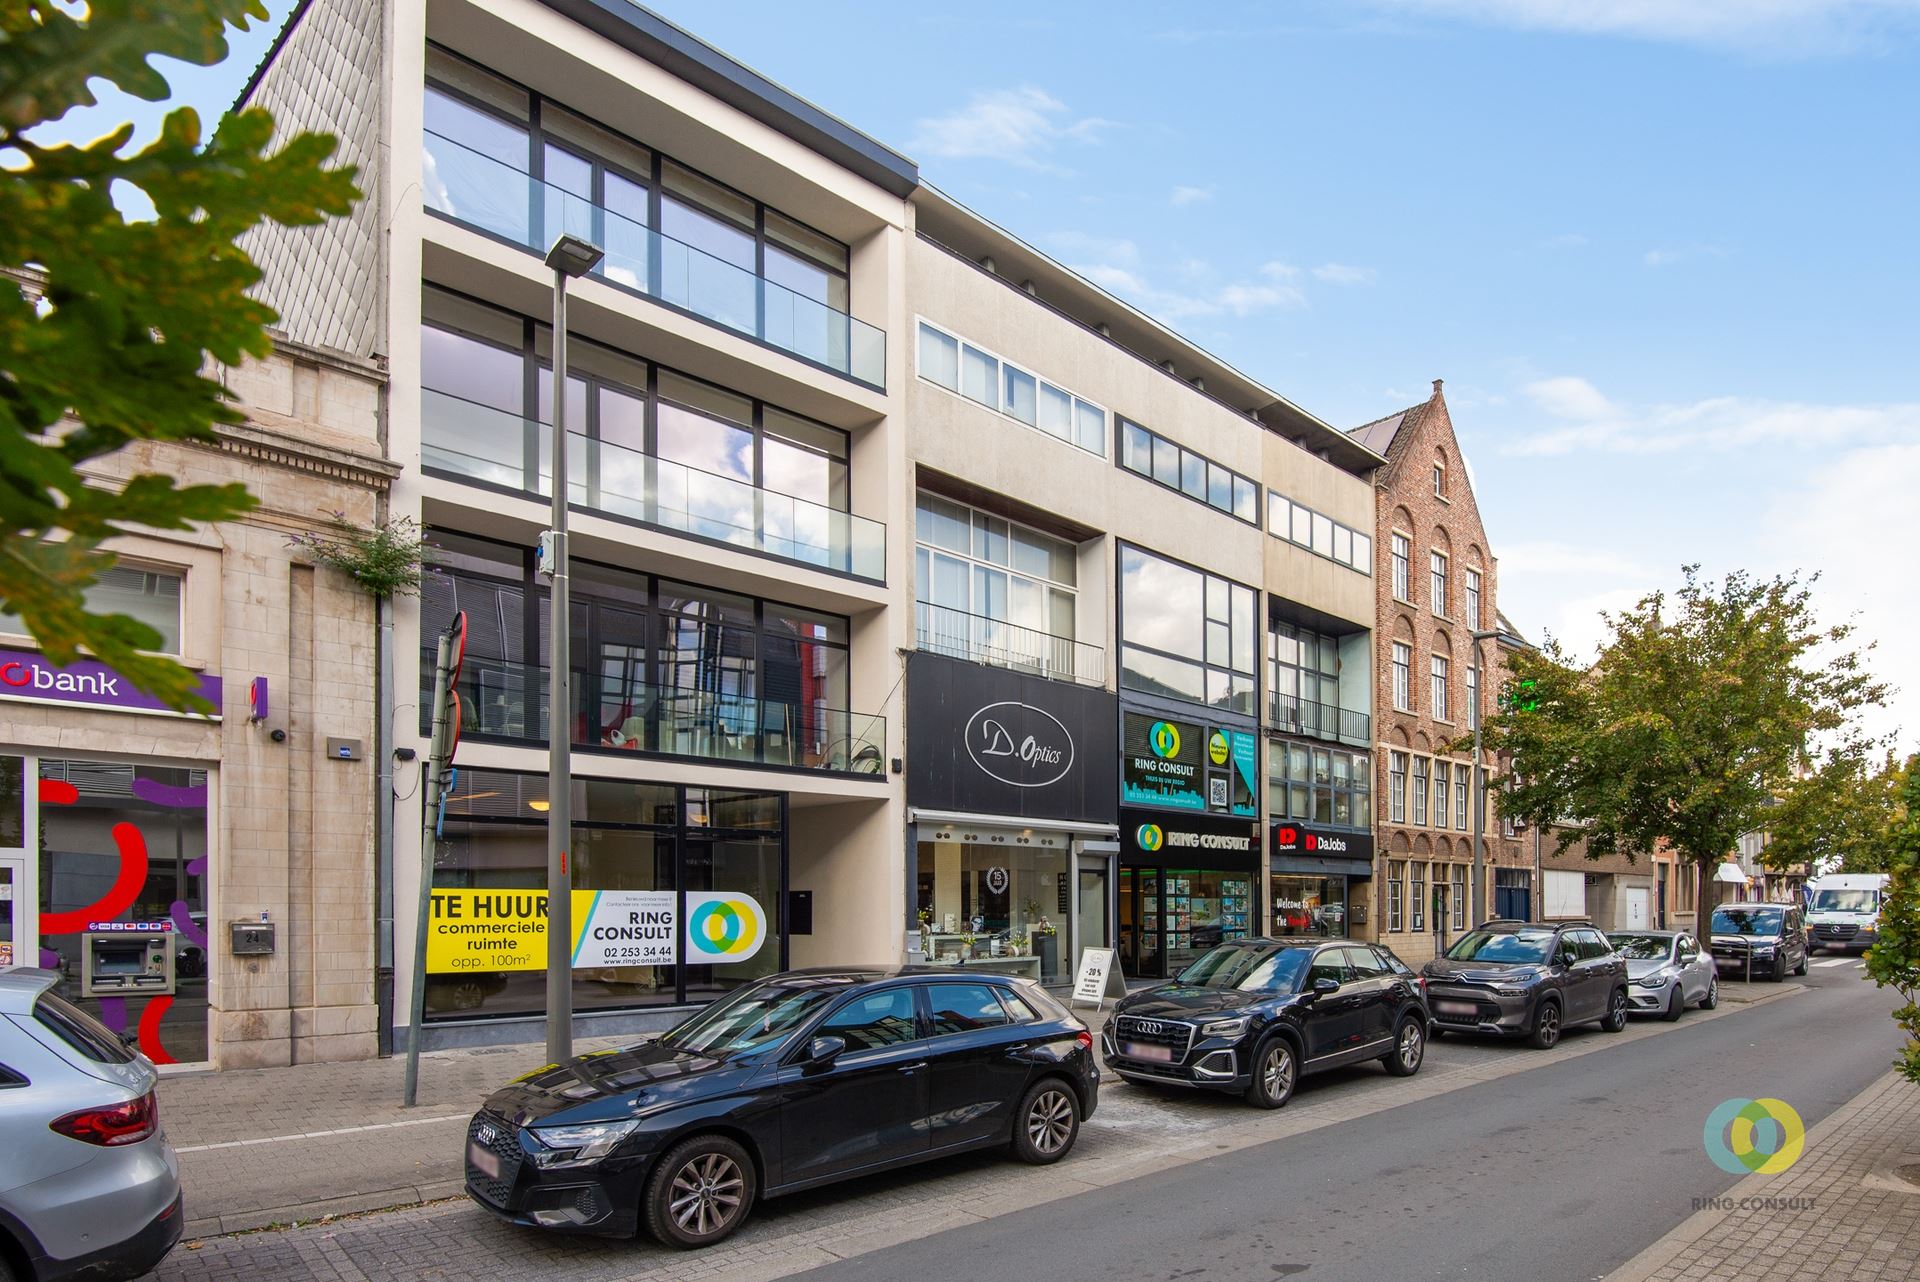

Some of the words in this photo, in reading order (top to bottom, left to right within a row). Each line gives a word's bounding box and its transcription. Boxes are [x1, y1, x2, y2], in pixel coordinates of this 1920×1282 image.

[1135, 758, 1157, 771] RING
[1158, 762, 1194, 776] CONSULT
[1167, 831, 1199, 848] RING
[1200, 834, 1250, 851] CONSULT
[1318, 837, 1347, 851] DaJobs
[993, 871, 1002, 880] 15
[430, 895, 461, 918] TE
[473, 896, 548, 918] HUUR
[1276, 898, 1301, 909] Welcome
[629, 911, 673, 924] RING
[1277, 914, 1287, 926] the
[438, 921, 545, 934] commerciele
[594, 927, 672, 940] CONSULT
[246, 933, 259, 943] 24
[467, 938, 517, 950] ruimte
[604, 947, 618, 958] 02
[621, 947, 640, 957] 253
[643, 947, 656, 956] 34
[659, 946, 671, 956] 44
[451, 958, 485, 969] opp.
[603, 957, 672, 965] www.ringconsult.be
